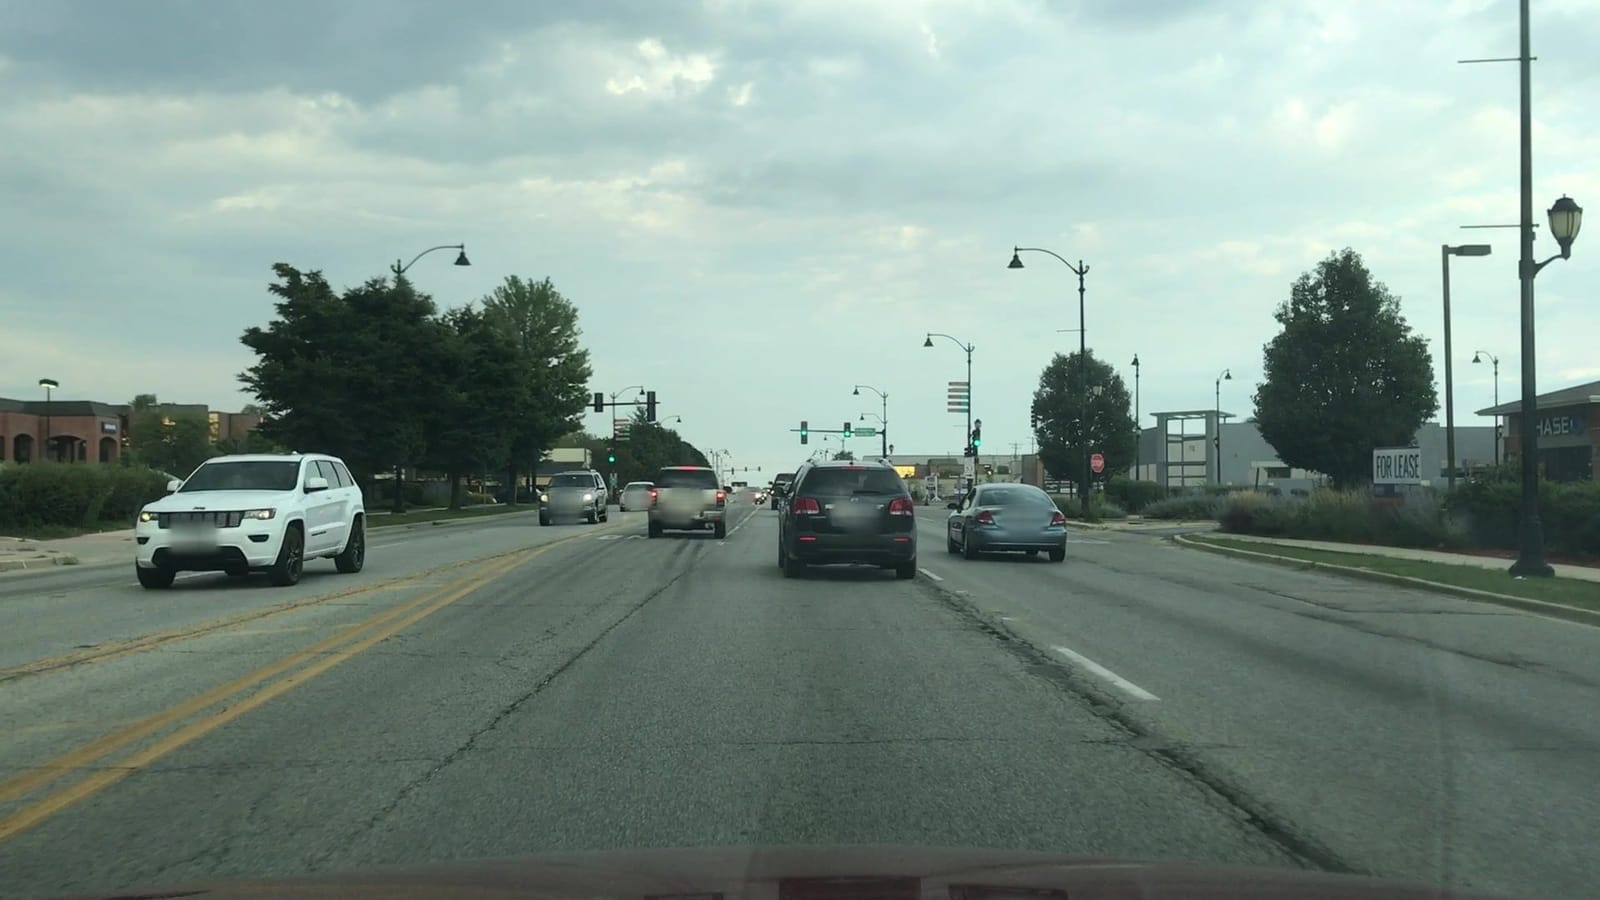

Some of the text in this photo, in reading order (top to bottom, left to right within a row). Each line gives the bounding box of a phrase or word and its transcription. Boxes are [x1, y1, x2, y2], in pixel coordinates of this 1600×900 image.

[1536, 416, 1569, 436] HASE
[1376, 454, 1420, 479] FOR LEASE
